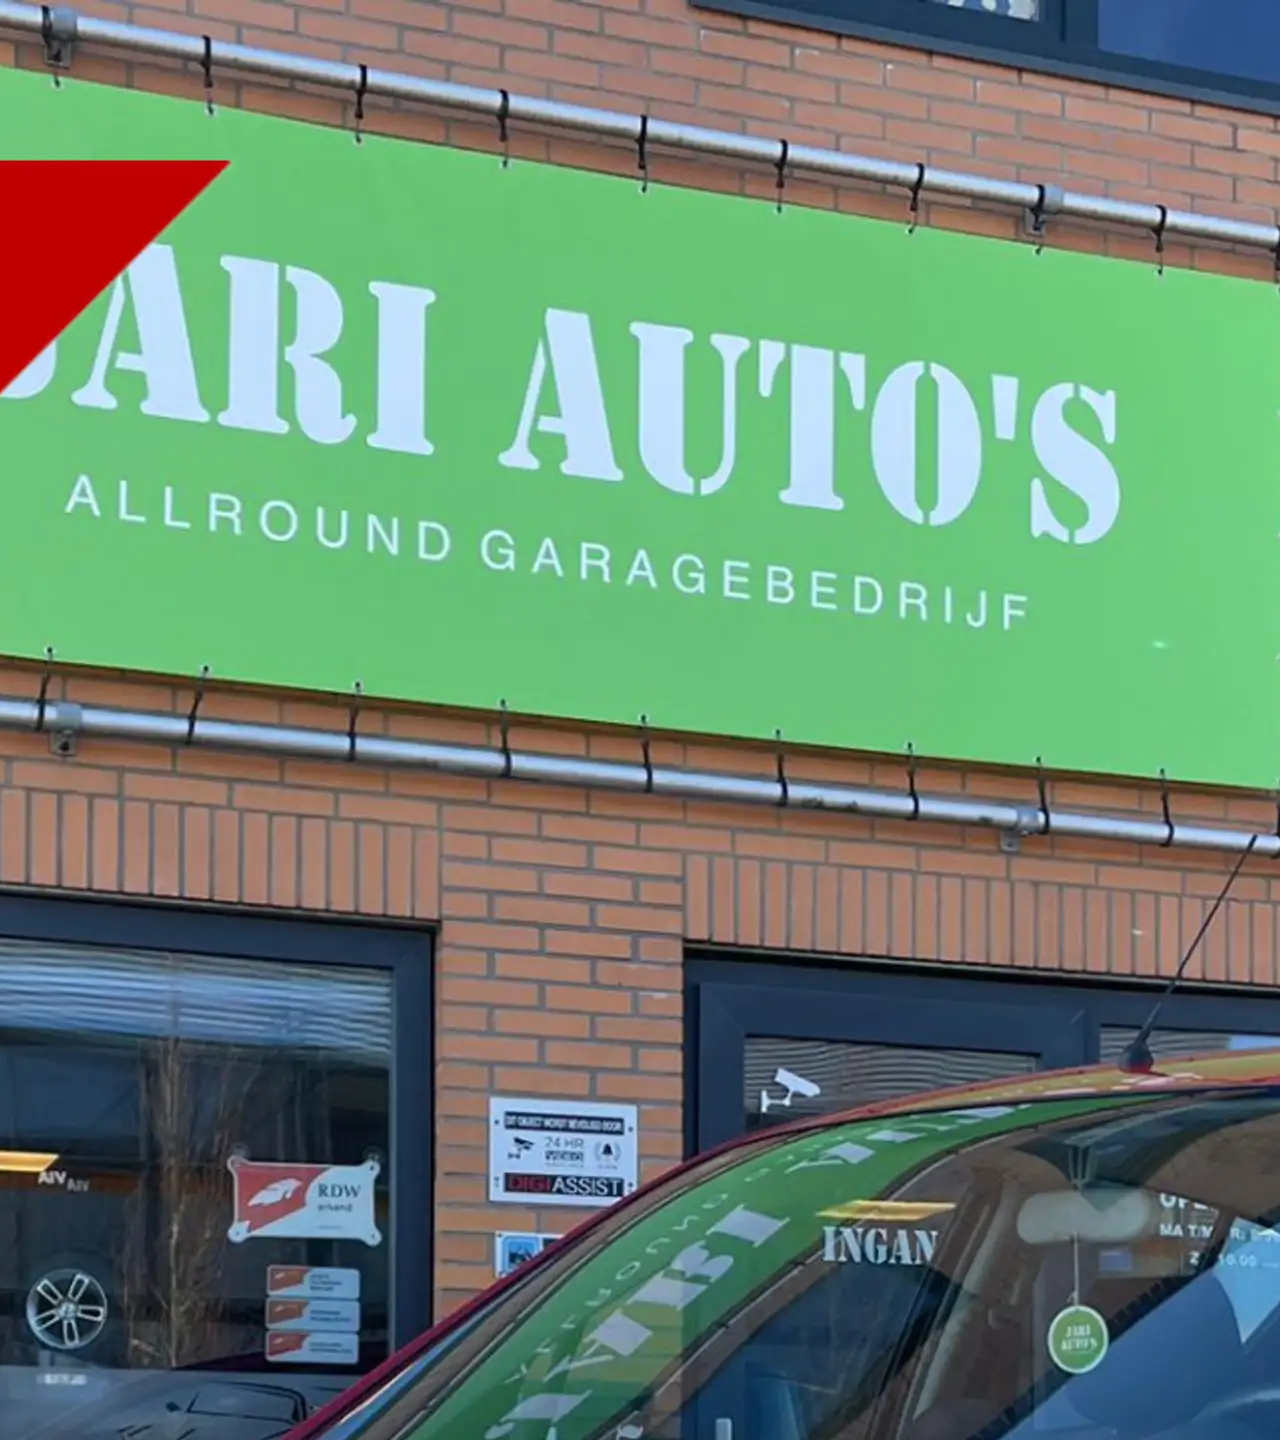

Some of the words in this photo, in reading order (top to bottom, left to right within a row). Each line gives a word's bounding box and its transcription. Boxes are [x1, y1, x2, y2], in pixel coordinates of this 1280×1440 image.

[0, 243, 436, 456] ARI
[498, 307, 1121, 544] AUTO'S
[65, 474, 451, 561] ALLROUND
[481, 529, 1027, 630] GARAGEBEDRIJF
[544, 1136, 561, 1148] 24
[564, 1137, 585, 1150] HR
[318, 1184, 361, 1198] RDW
